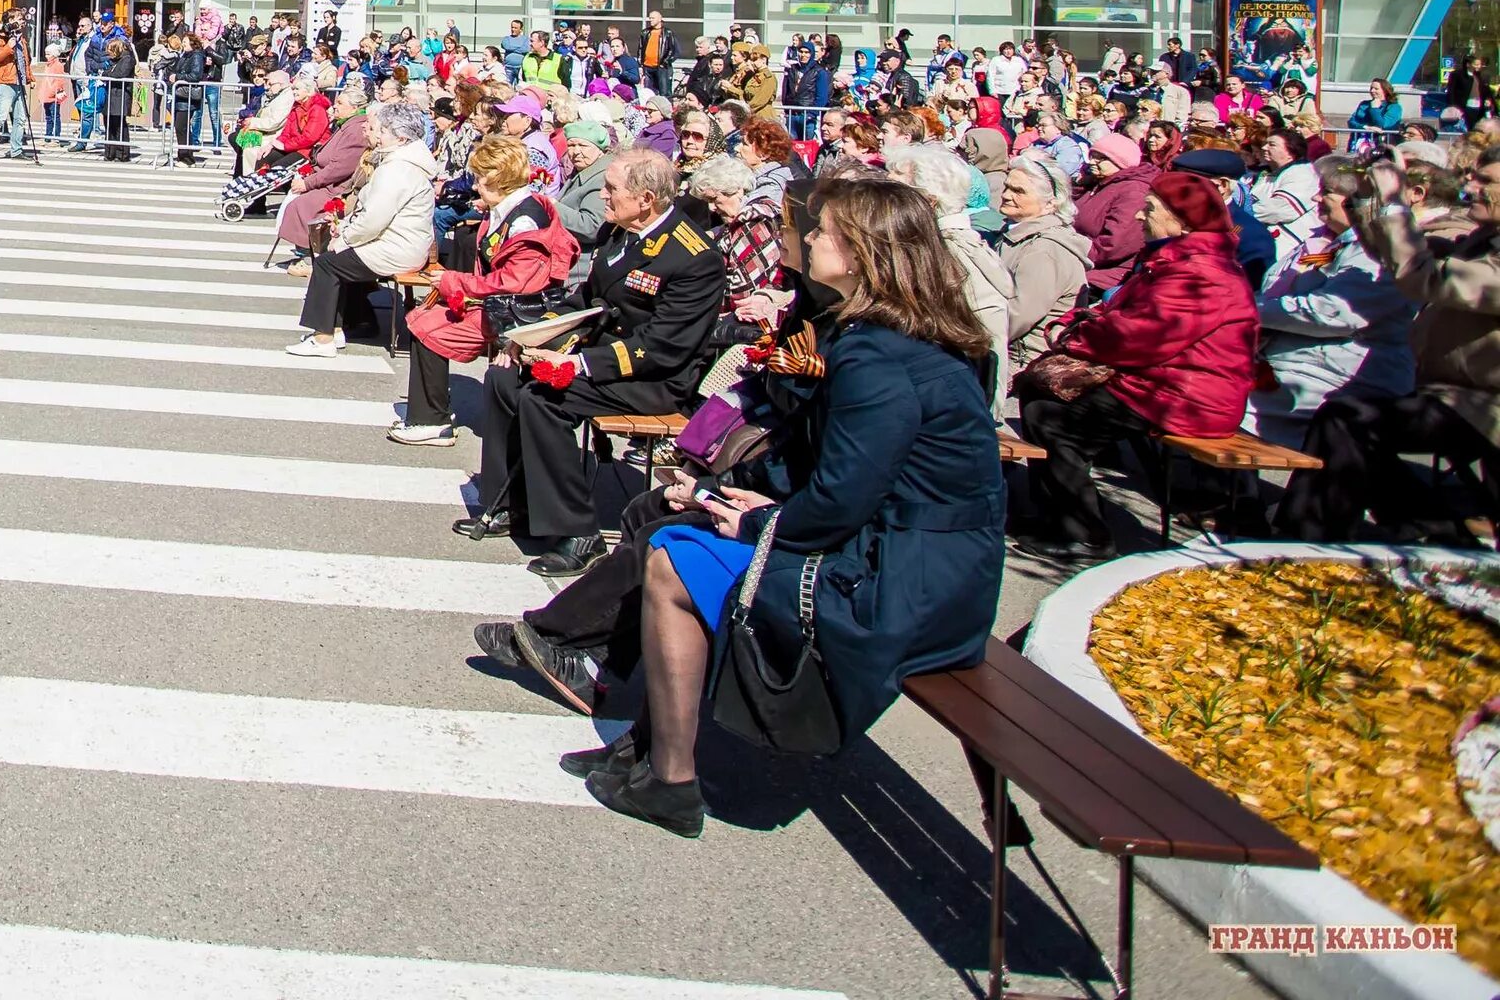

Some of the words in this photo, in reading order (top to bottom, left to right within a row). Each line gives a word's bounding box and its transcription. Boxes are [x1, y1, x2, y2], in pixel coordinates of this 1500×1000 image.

[1239, 3, 1310, 11] БЕЛОСНЕЖКА
[1242, 10, 1273, 18] СЕМЬ
[1276, 10, 1315, 19] ГНОМОВ
